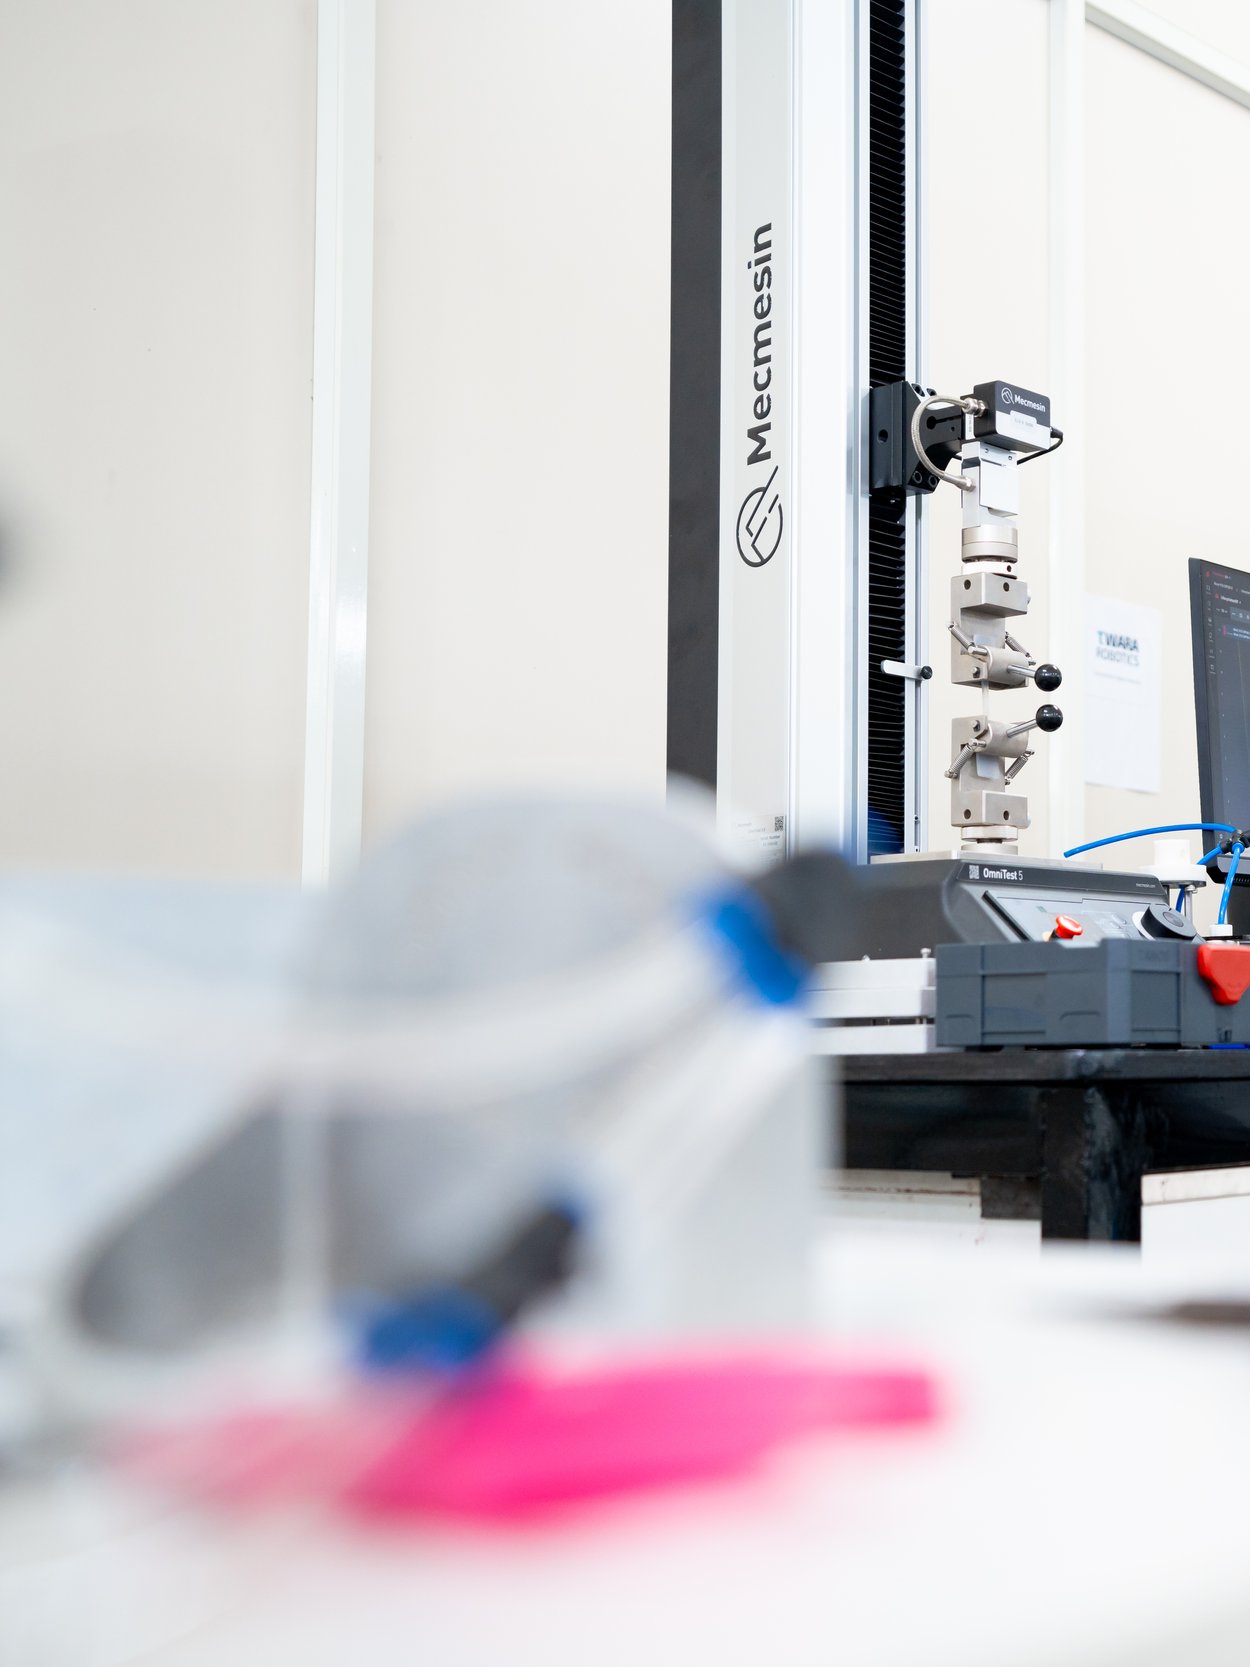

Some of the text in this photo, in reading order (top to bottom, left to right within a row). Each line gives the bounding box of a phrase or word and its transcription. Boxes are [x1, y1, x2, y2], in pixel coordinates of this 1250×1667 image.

[747, 222, 772, 466] Mecmesin
[1014, 394, 1046, 413] Mecmesin
[983, 868, 1024, 881] OmniTest 5
